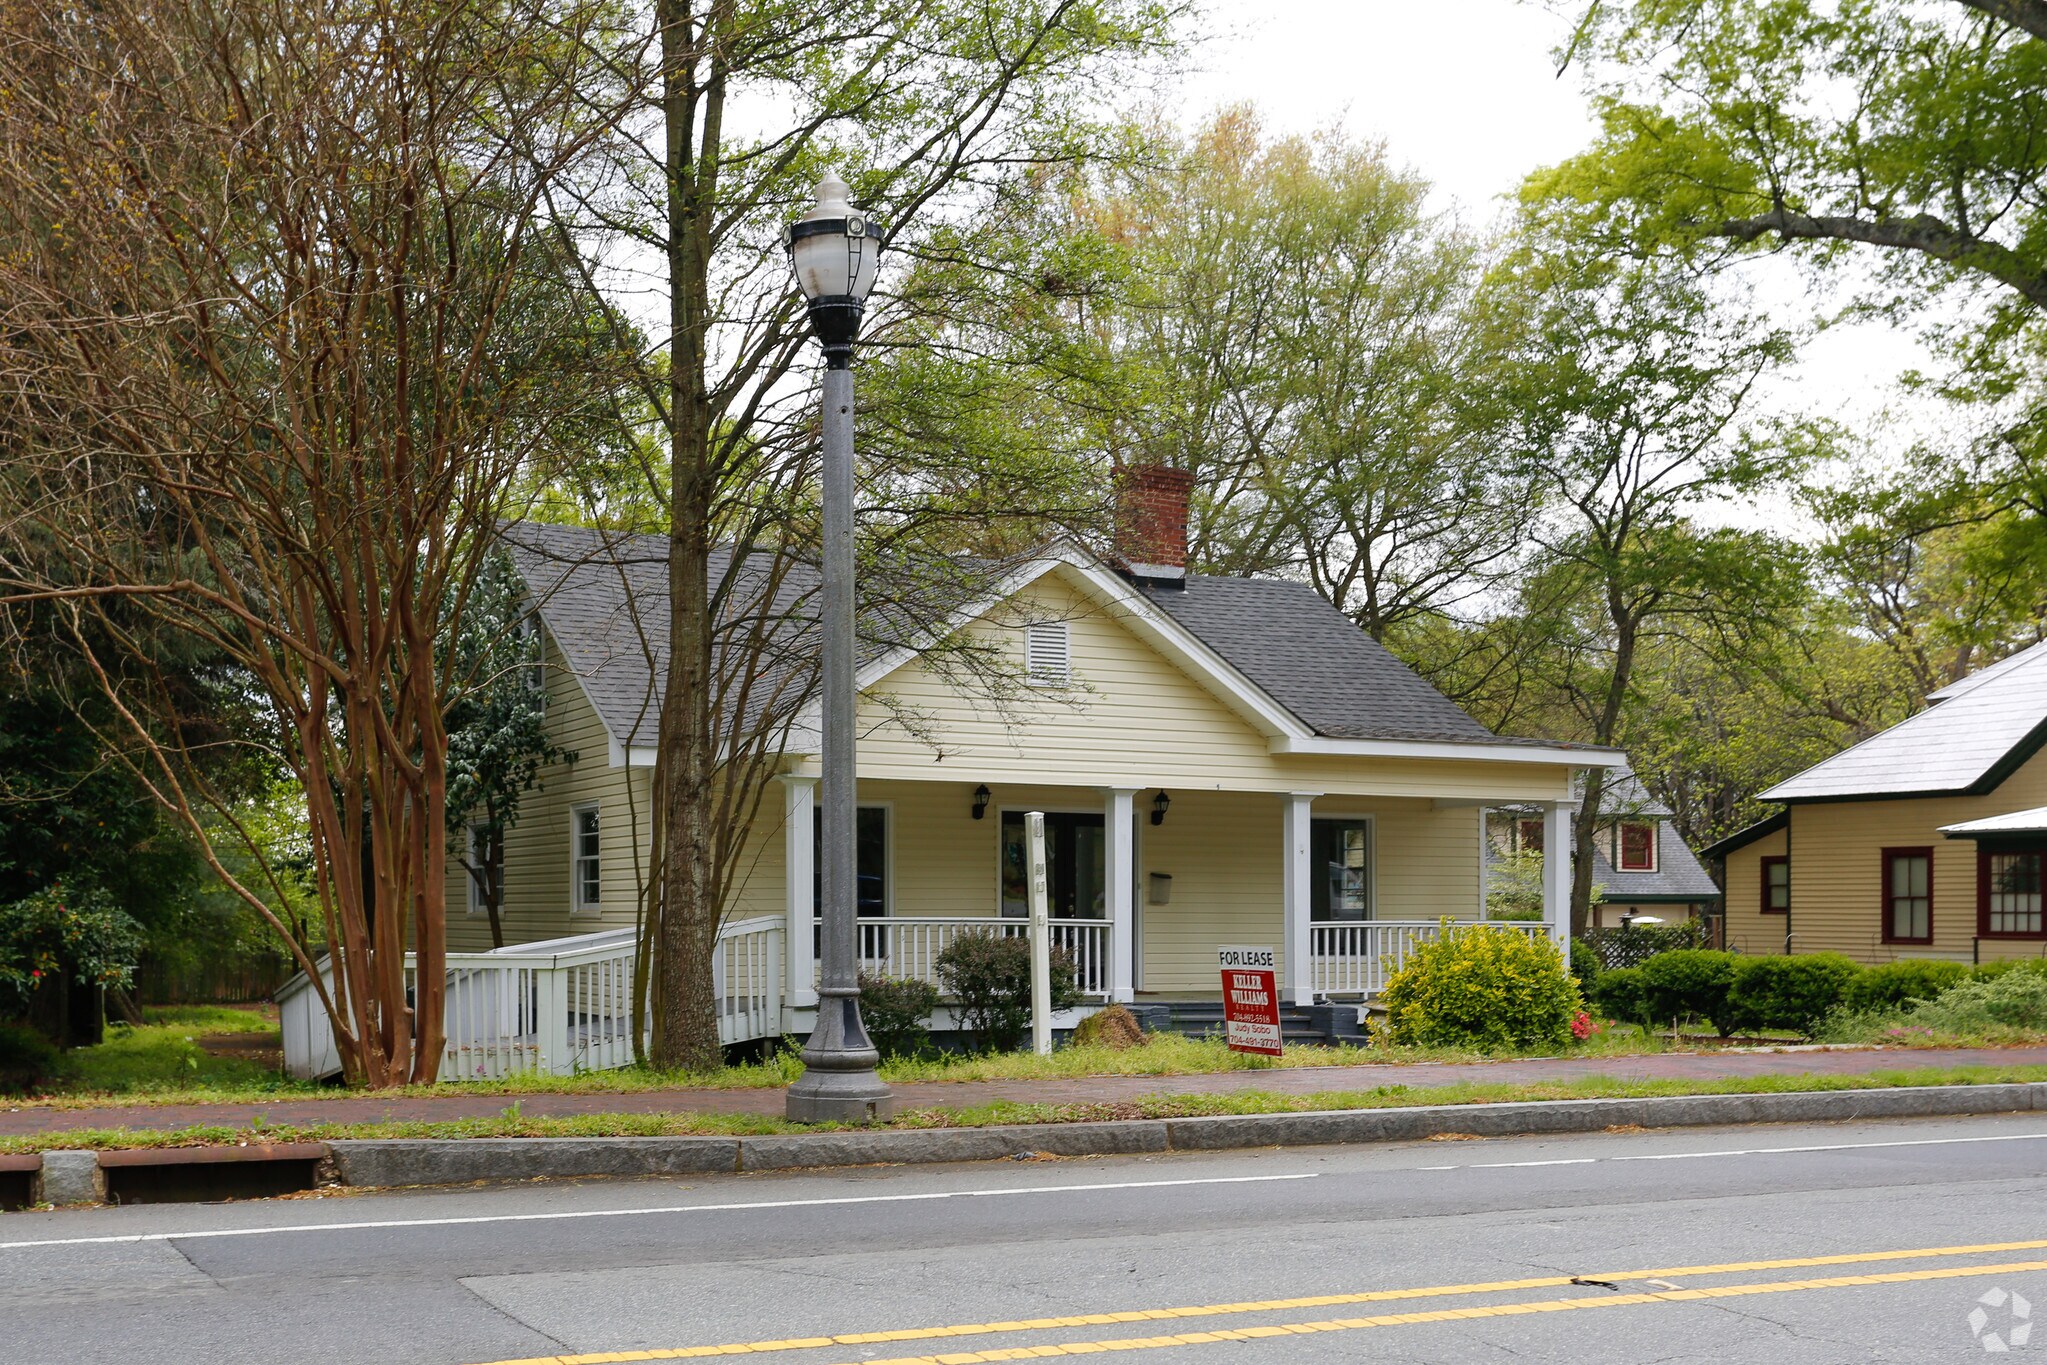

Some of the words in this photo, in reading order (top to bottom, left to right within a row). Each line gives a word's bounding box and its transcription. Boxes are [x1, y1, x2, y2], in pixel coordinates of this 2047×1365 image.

[1219, 951, 1240, 966] FOR
[1241, 951, 1273, 967] LEASE
[1233, 974, 1263, 990] KELLER
[1230, 990, 1269, 1006] WILLIAMS
[1235, 1023, 1250, 1034] Judy
